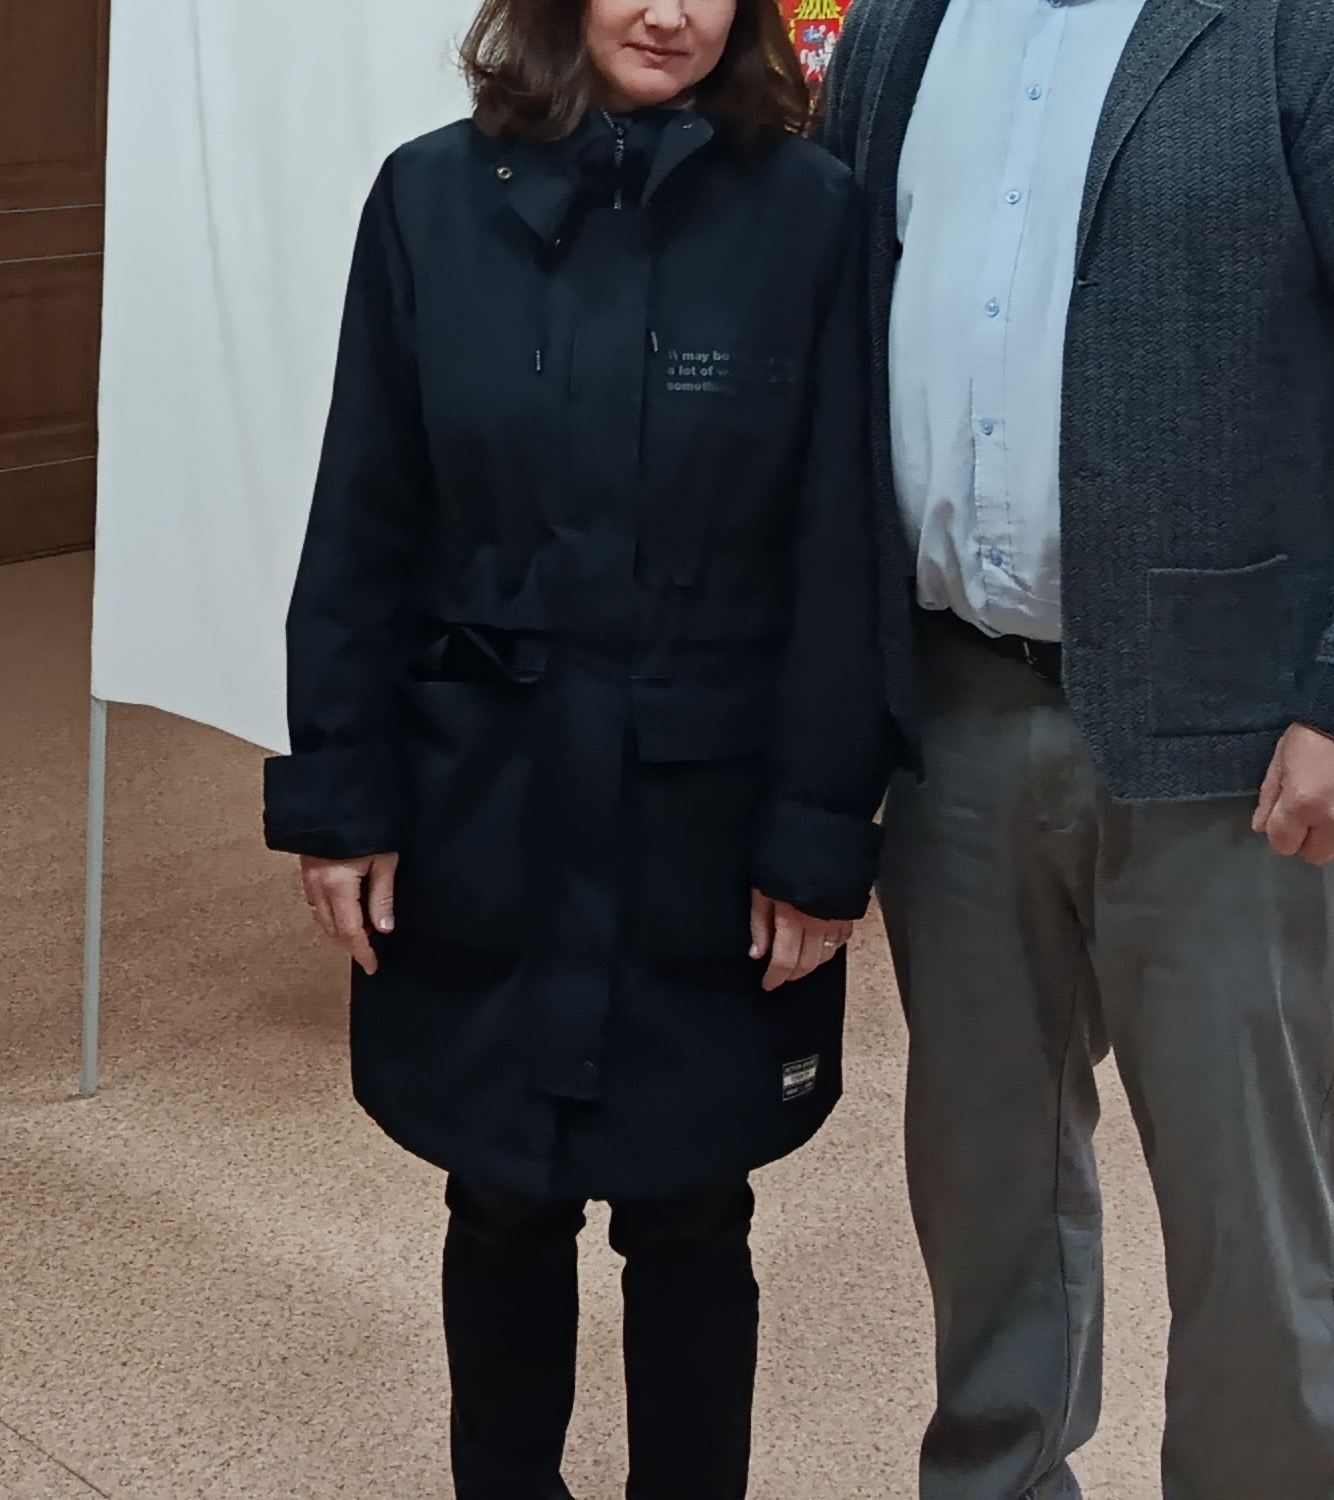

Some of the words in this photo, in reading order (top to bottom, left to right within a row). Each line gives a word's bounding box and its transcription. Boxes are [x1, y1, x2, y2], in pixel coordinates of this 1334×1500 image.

[682, 351, 710, 363] may
[679, 365, 696, 376] lot
[700, 365, 714, 376] of
